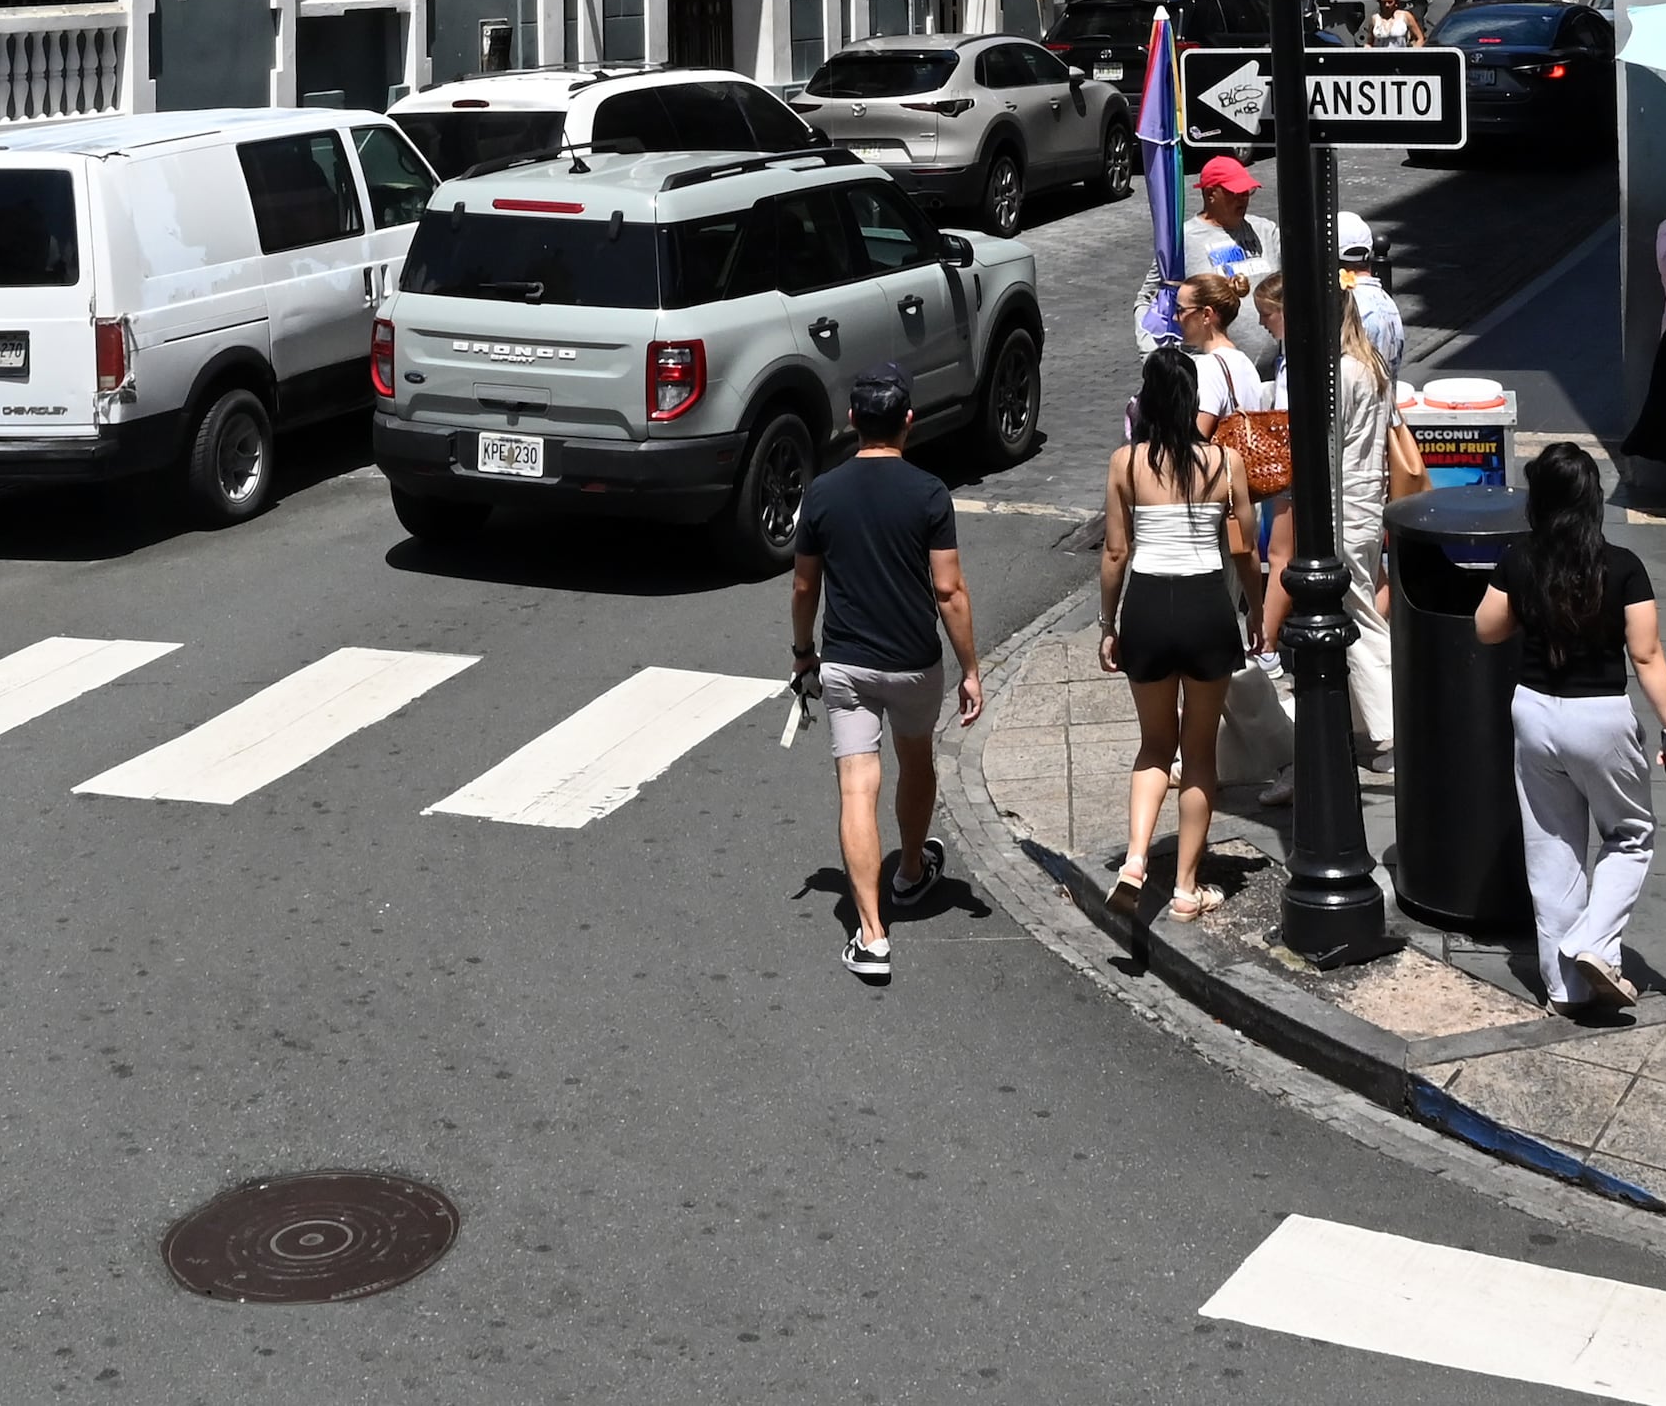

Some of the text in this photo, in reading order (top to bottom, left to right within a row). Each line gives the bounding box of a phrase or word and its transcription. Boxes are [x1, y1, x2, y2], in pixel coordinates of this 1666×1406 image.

[453, 341, 576, 360] BRONCO
[490, 354, 535, 364] SPORT
[2, 406, 68, 416] CHEVROLET
[1415, 430, 1480, 440] COCONUT
[1459, 442, 1497, 453] FRUIT
